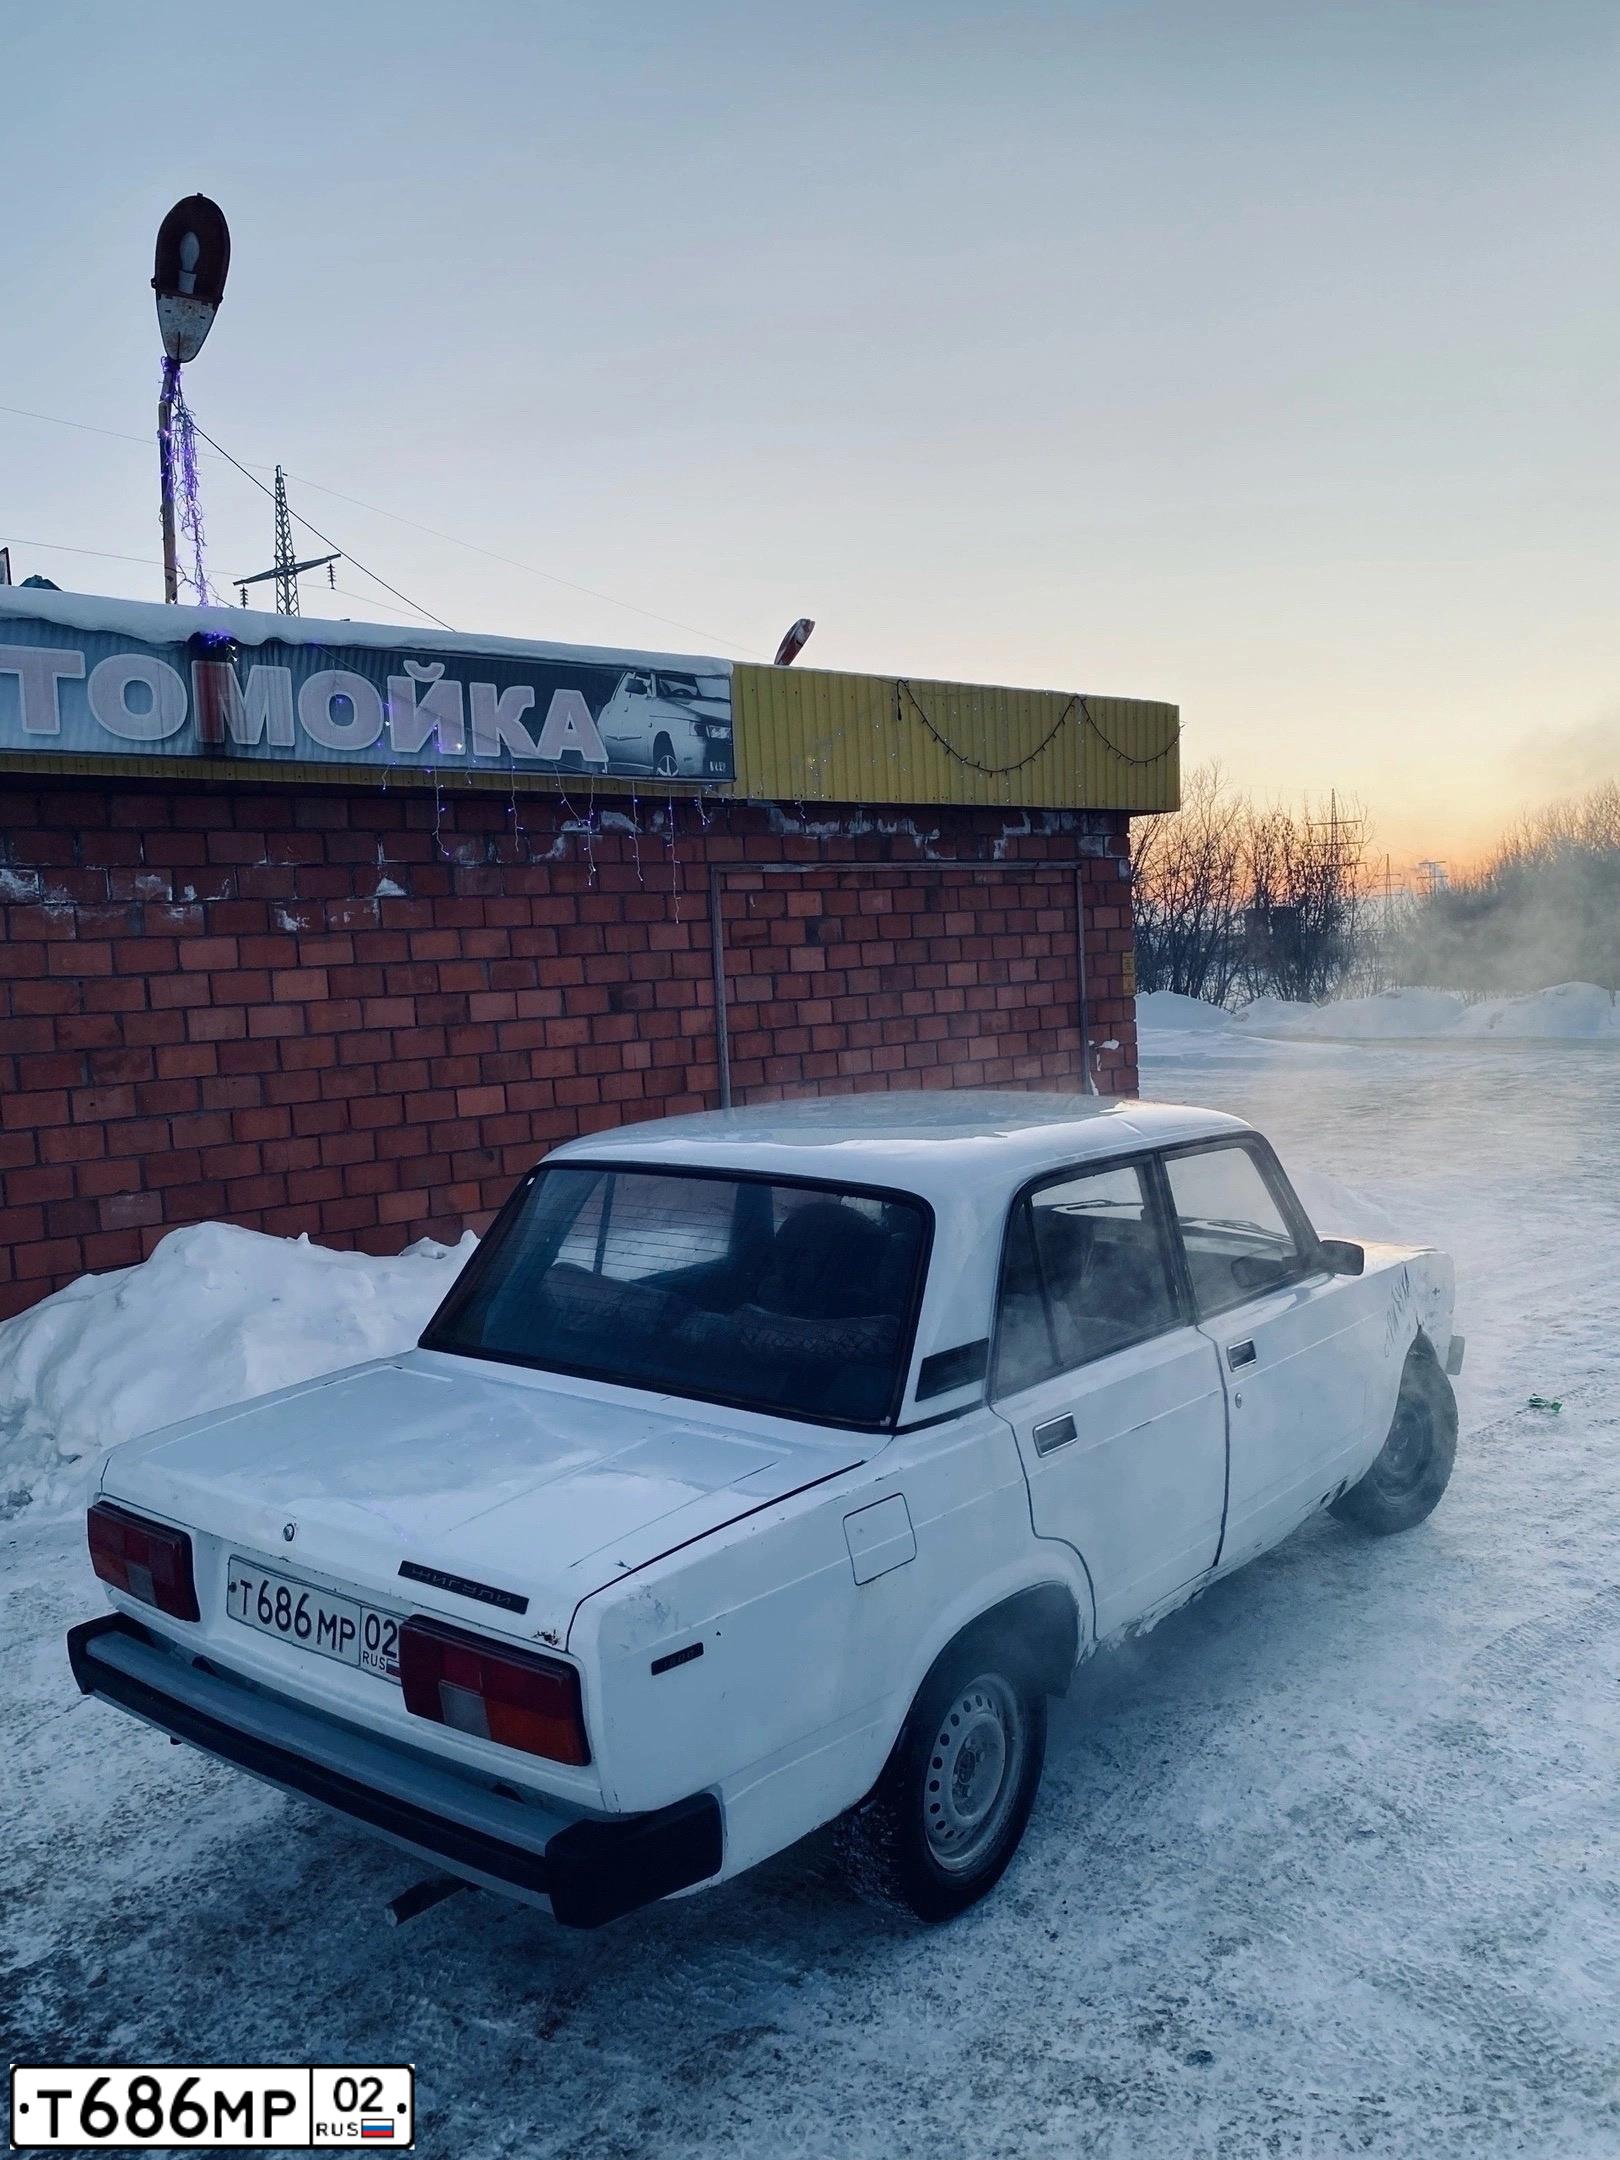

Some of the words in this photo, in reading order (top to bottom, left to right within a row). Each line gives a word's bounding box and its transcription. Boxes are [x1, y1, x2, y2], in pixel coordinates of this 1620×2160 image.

[0, 644, 609, 763] ТОМОЙКА
[240, 1579, 356, 1653] Т686МР
[364, 1613, 398, 1659] 02
[362, 1650, 386, 1671] RUS
